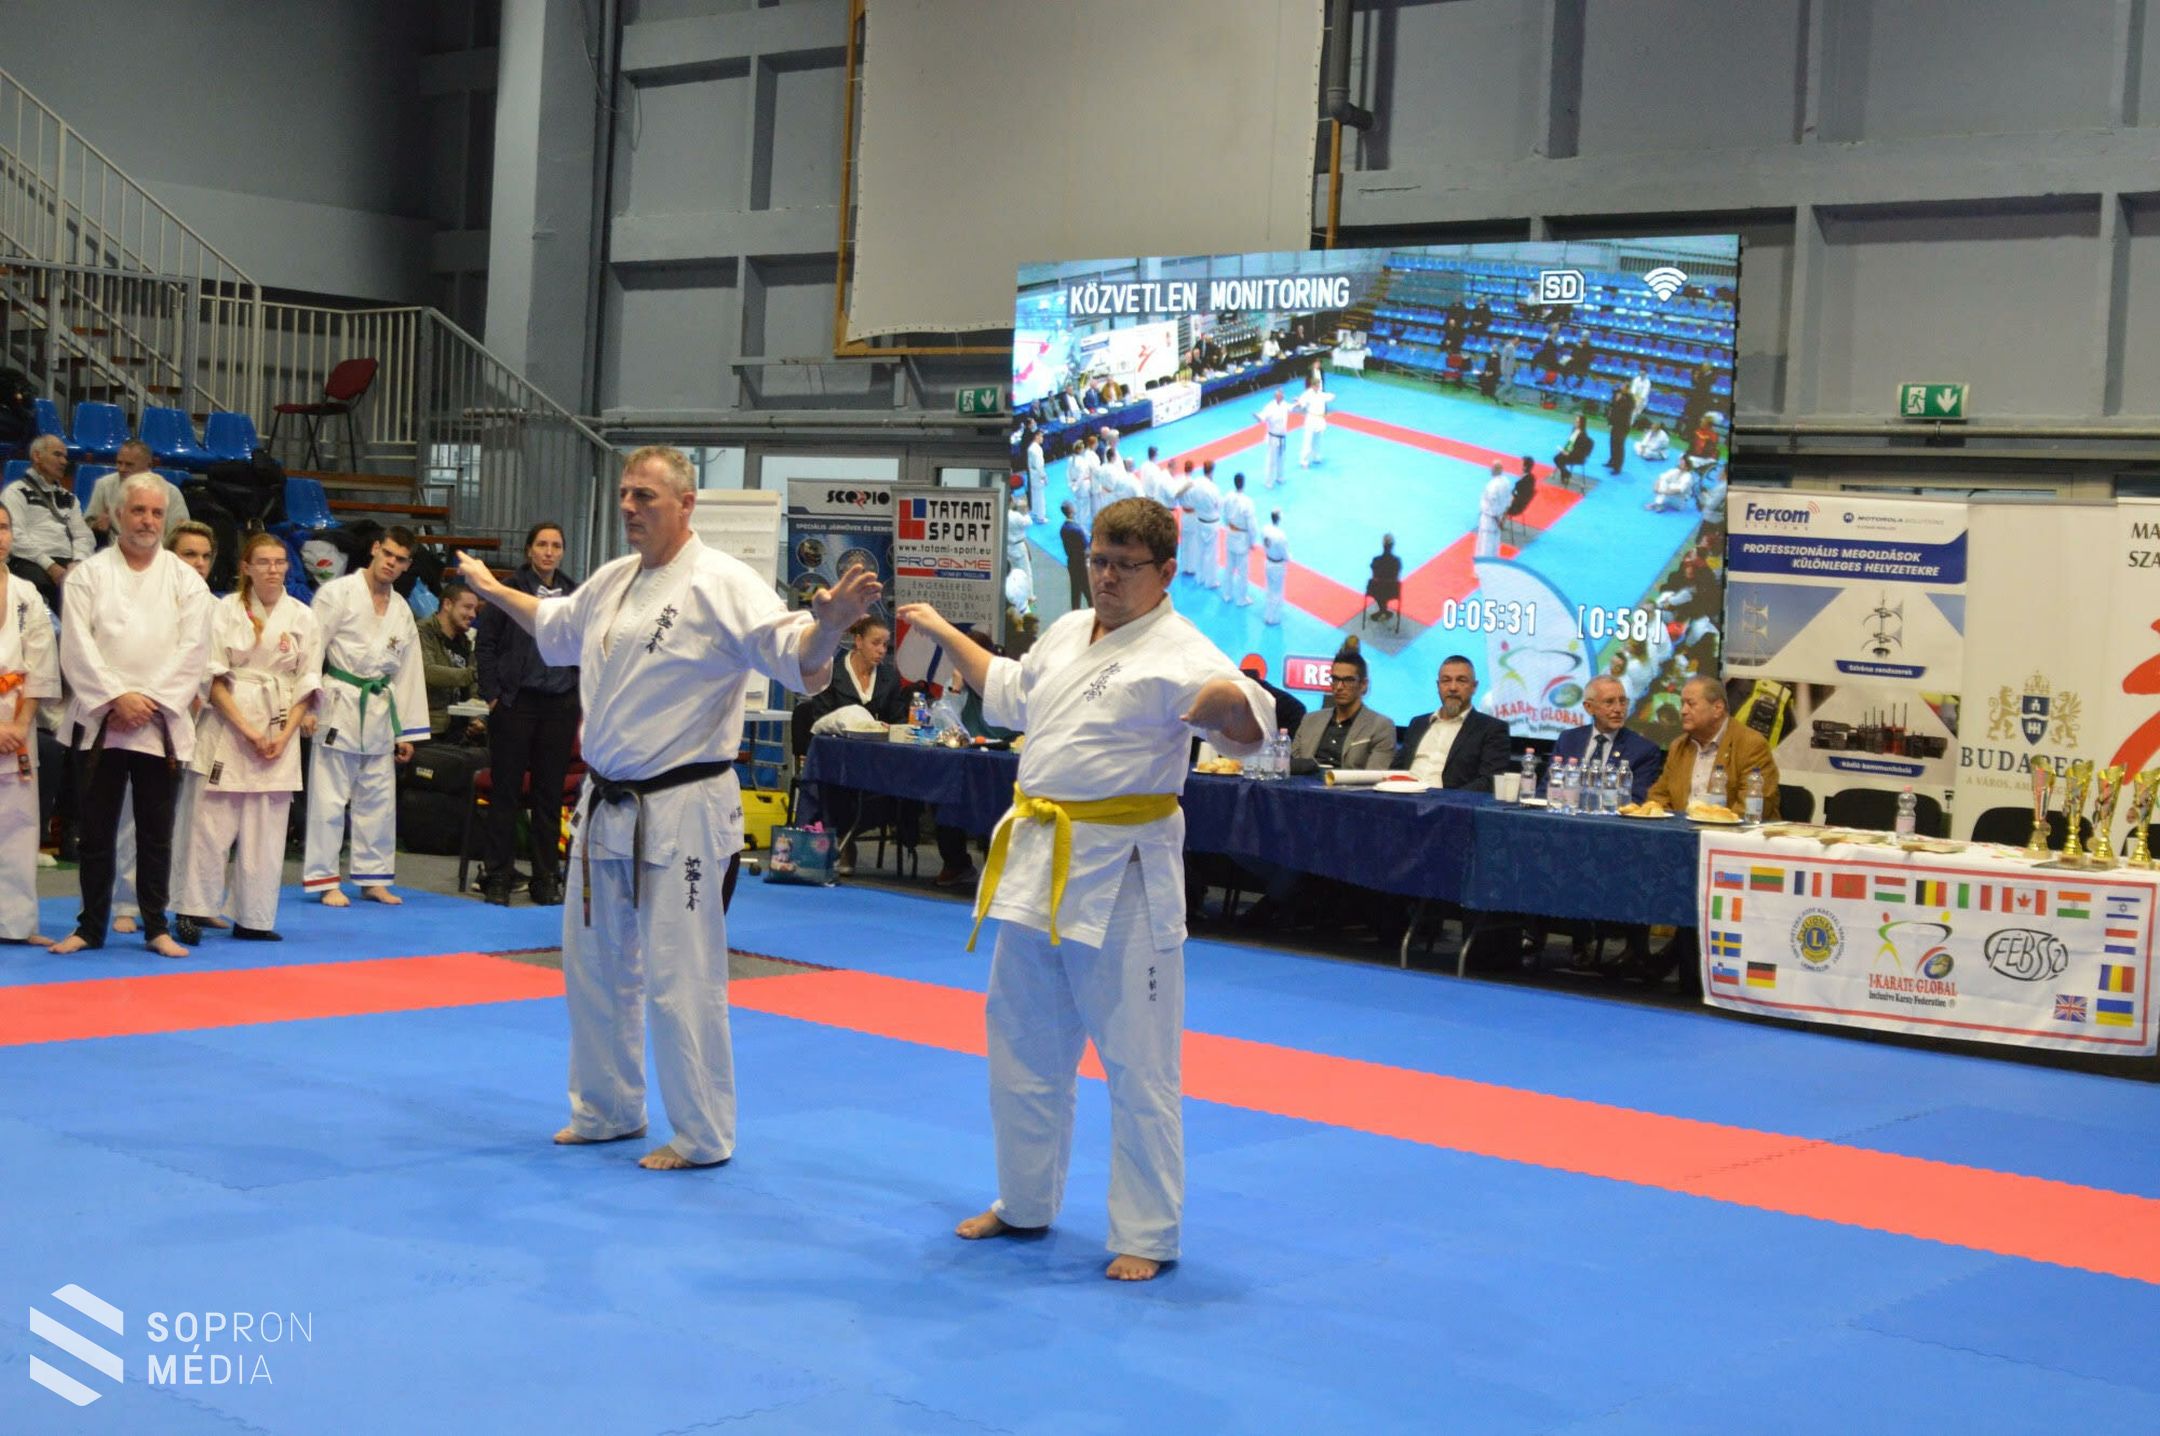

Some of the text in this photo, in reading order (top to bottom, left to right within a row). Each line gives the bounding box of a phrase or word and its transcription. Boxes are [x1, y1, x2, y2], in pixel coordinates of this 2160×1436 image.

[1070, 277, 1350, 314] KÖZVETLEN MONITORING
[1545, 275, 1577, 299] SD
[929, 500, 992, 520] TATAMI
[1745, 502, 1810, 524] Fercom
[928, 522, 991, 542] SPORT
[898, 544, 992, 556] www.tatami-sport.eu
[1743, 543, 1922, 562] PROFESSZIONÁLIS MEGOLDÁSOK
[897, 556, 992, 570] PROGAME
[1792, 556, 1941, 576] KÜLÖNLEGES HELYZETEKRE
[1443, 598, 1662, 644] 0:05:31 [0:58]
[1304, 663, 1333, 687] RE
[1916, 979, 1958, 996] GLOBAL
